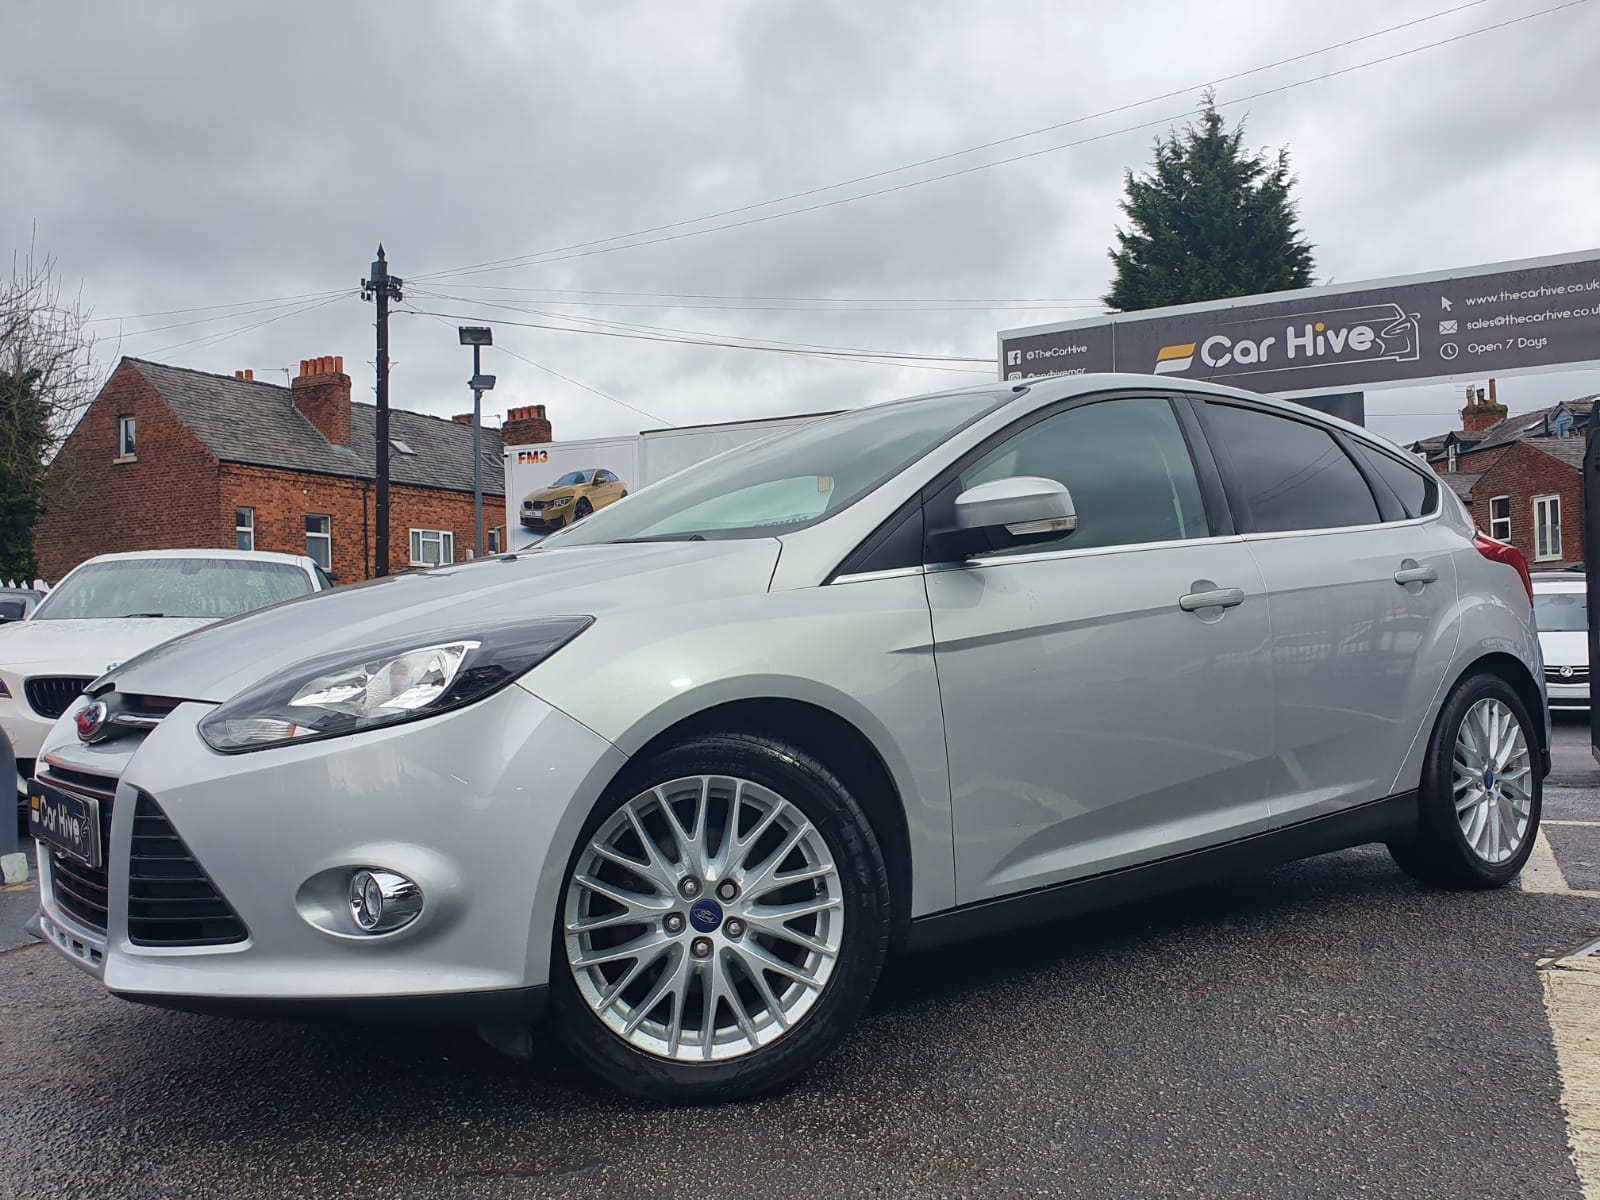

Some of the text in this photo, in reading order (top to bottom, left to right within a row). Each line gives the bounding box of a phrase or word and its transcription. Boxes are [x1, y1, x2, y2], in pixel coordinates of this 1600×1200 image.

[1465, 279, 1600, 306] www.thecarhive.co.uk
[1026, 344, 1088, 360] @TheCarHive
[1200, 322, 1375, 368] Car Hive
[1467, 336, 1548, 355] Open 7 Days
[518, 450, 549, 465] FM3
[40, 794, 80, 846] Car Hive
